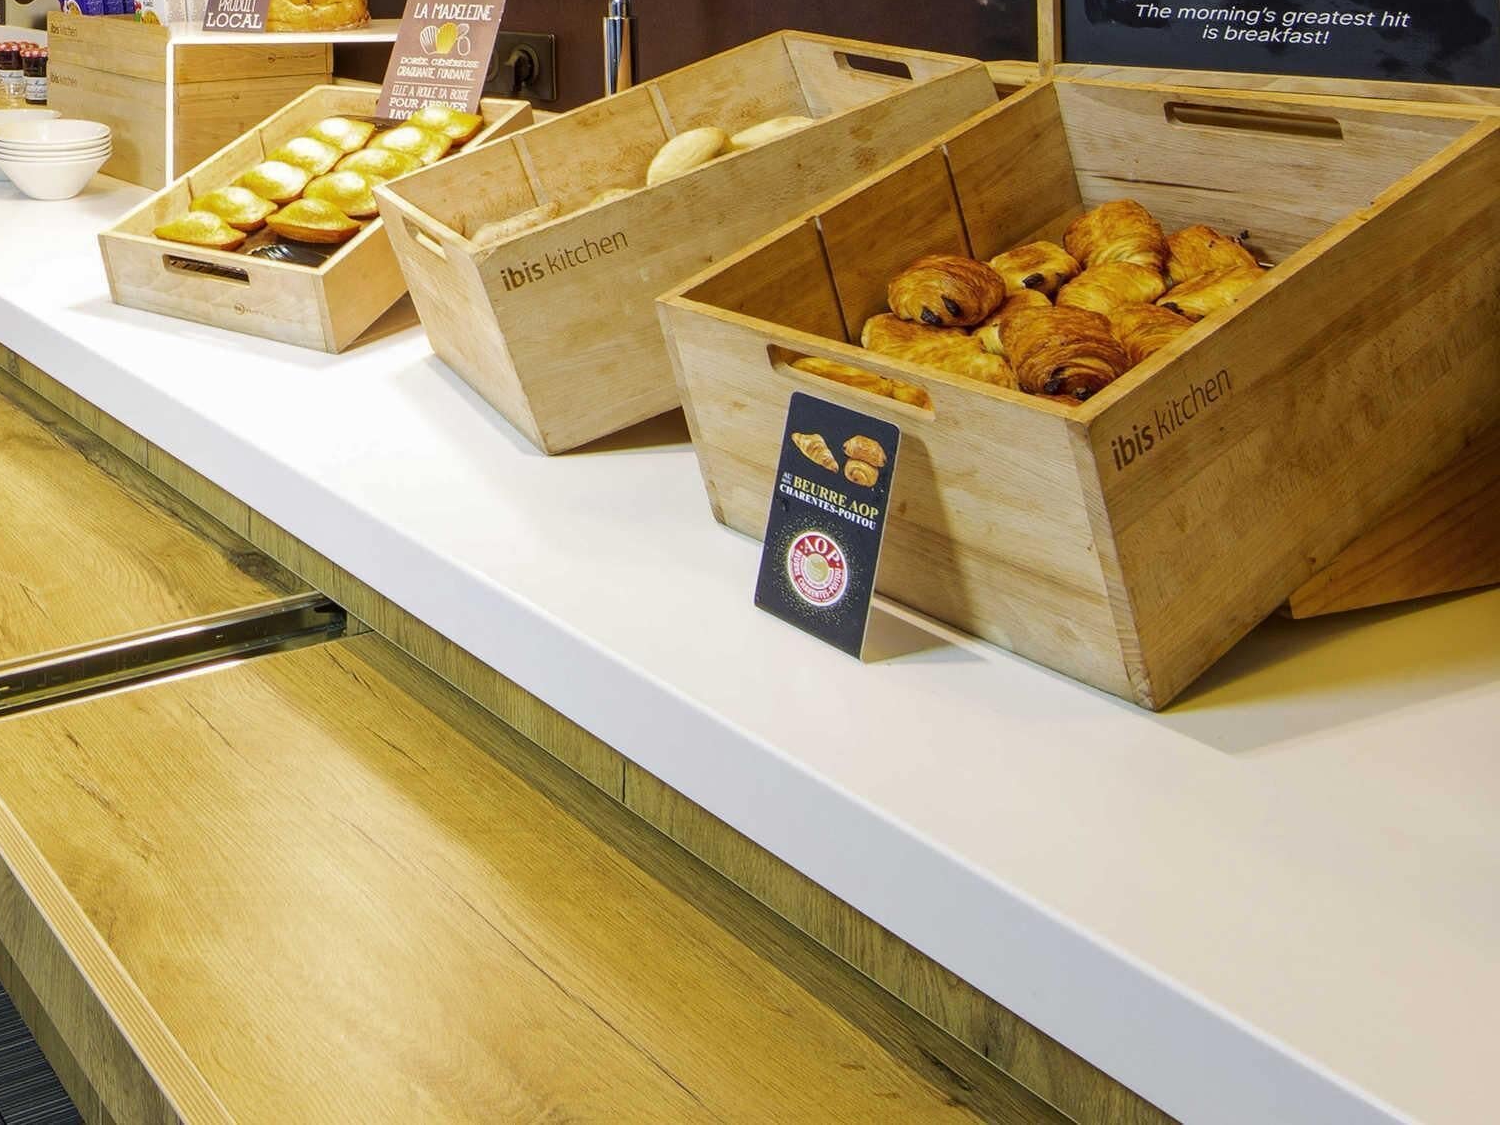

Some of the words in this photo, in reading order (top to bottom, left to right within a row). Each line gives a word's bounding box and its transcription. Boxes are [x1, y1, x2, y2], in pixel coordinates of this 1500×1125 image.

[205, 12, 263, 29] LOCAL
[414, 2, 430, 19] LA
[431, 3, 495, 21] MADELEINE
[1135, 4, 1171, 19] The
[1177, 5, 1276, 24] morning's
[1281, 10, 1375, 28] greatest
[1380, 11, 1411, 29] hit
[1202, 25, 1218, 40] is
[1223, 26, 1331, 45] breakfast!
[389, 97, 419, 109] POUR
[408, 85, 415, 97] A
[500, 261, 546, 292] ibis
[545, 231, 629, 276] kitchen
[1111, 424, 1155, 472] ibis
[1153, 369, 1232, 441] kitchen
[779, 484, 878, 530] CHARENTES-POITOU
[792, 475, 848, 508] BEURRE
[848, 500, 880, 520] AOP
[803, 537, 841, 563] AOP
